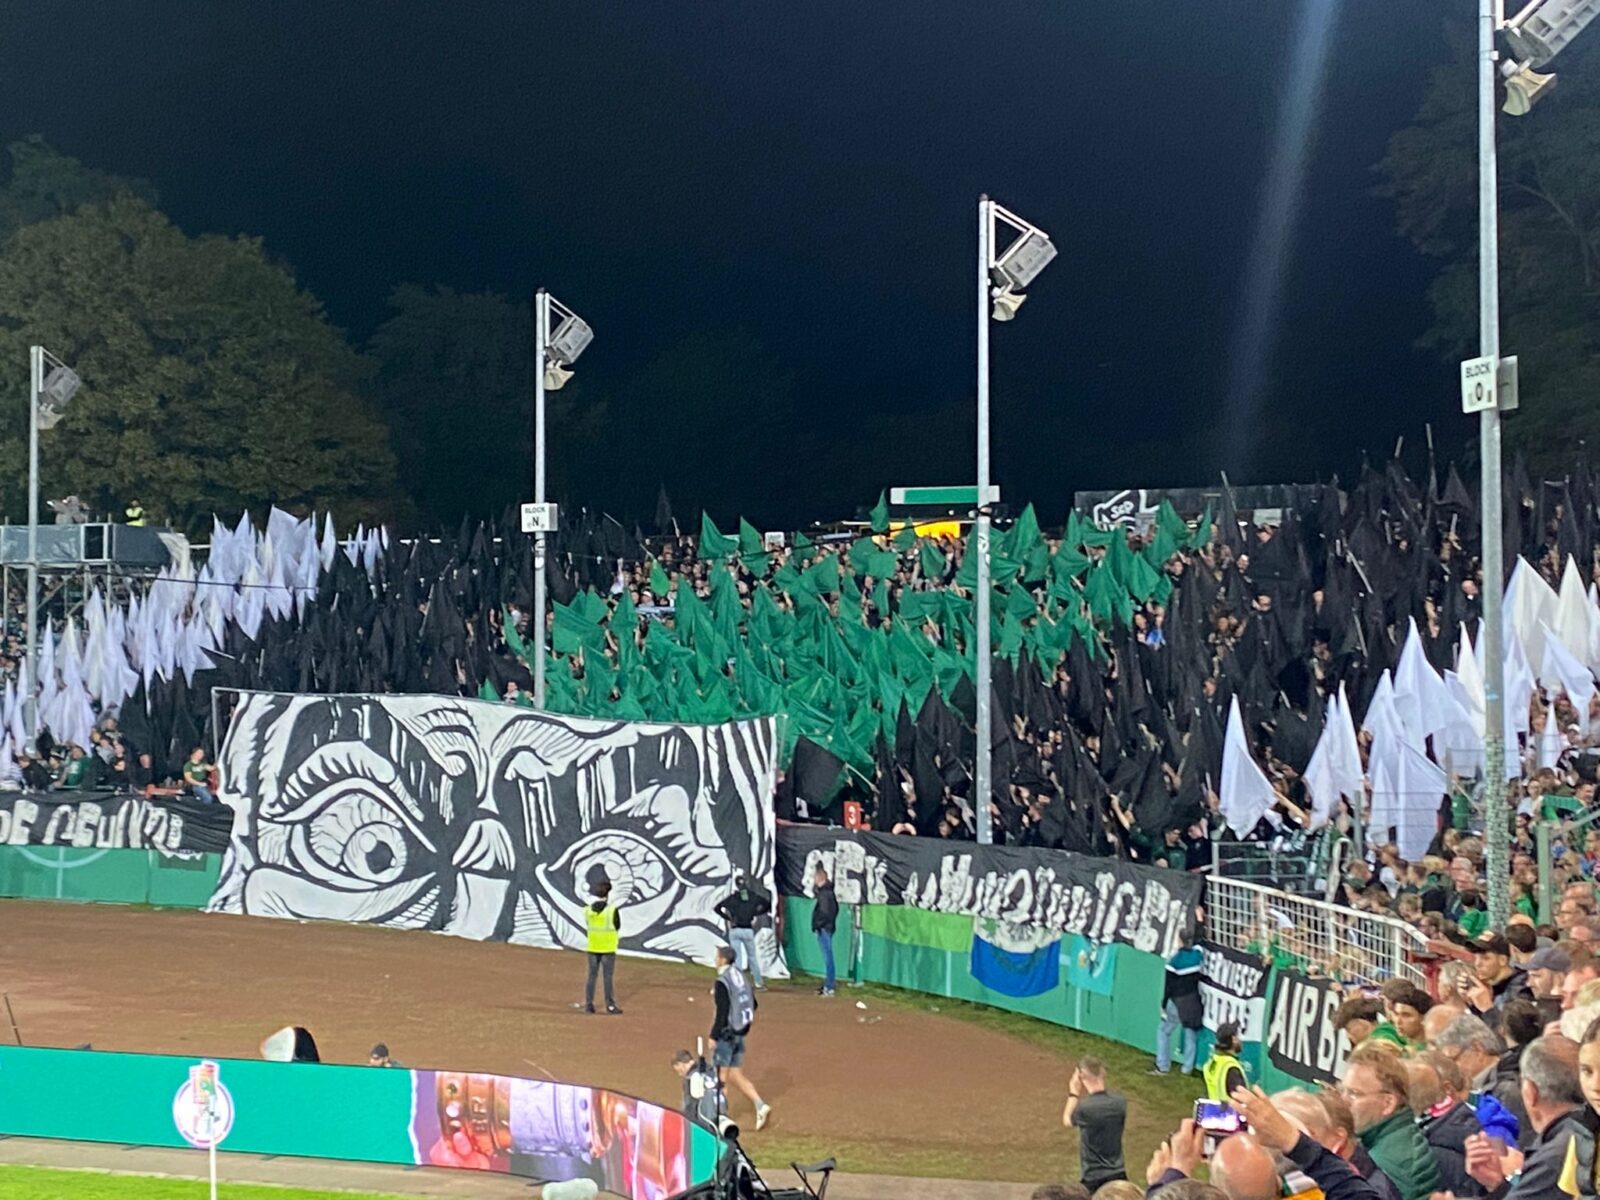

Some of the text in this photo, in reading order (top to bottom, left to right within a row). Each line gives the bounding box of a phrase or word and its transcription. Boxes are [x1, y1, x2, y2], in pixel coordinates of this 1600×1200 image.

[1465, 361, 1490, 378] BLOCK
[532, 516, 540, 527] N
[848, 805, 856, 825] 3
[1267, 976, 1319, 1067] AIR
